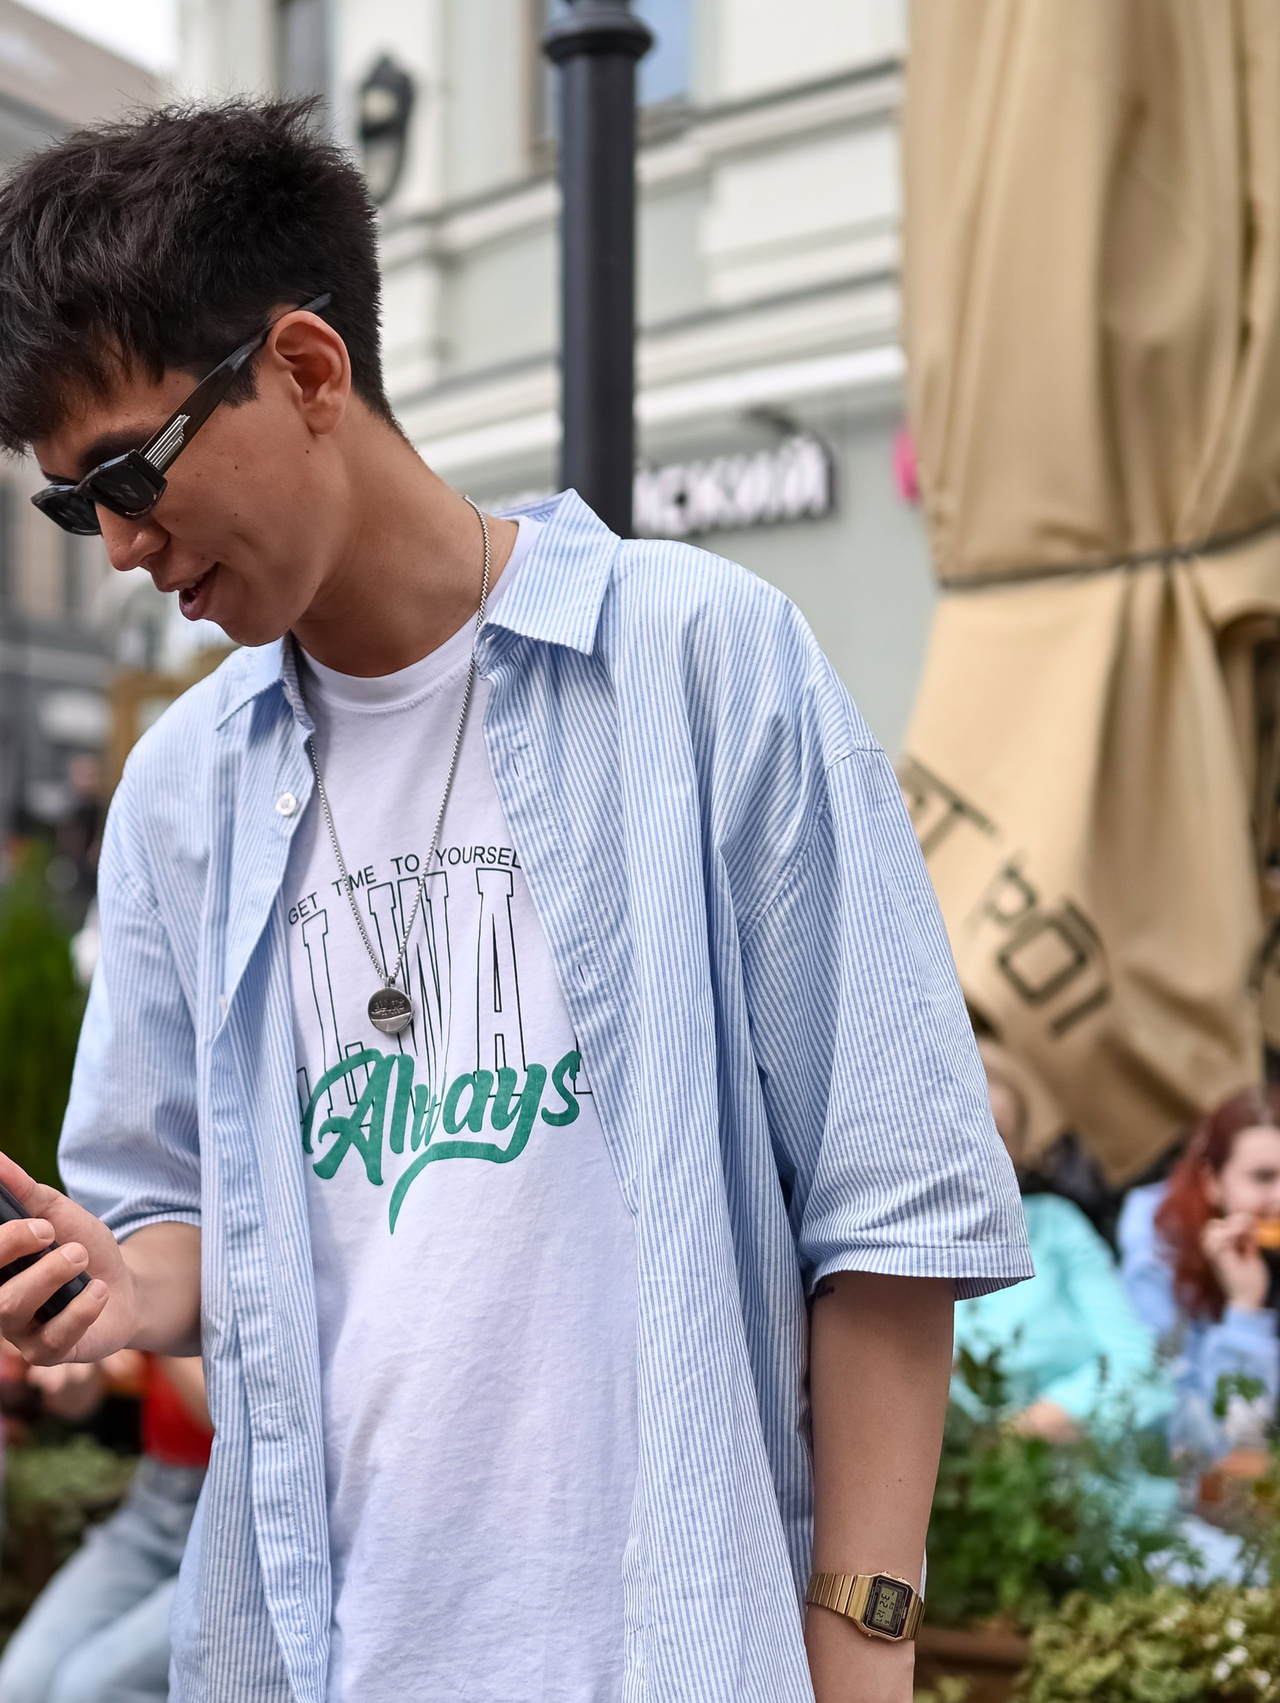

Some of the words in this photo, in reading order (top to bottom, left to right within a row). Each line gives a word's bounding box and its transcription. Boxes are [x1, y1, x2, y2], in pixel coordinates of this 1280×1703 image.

[288, 892, 320, 926] GET
[331, 865, 377, 897] TME
[390, 853, 420, 876] TO
